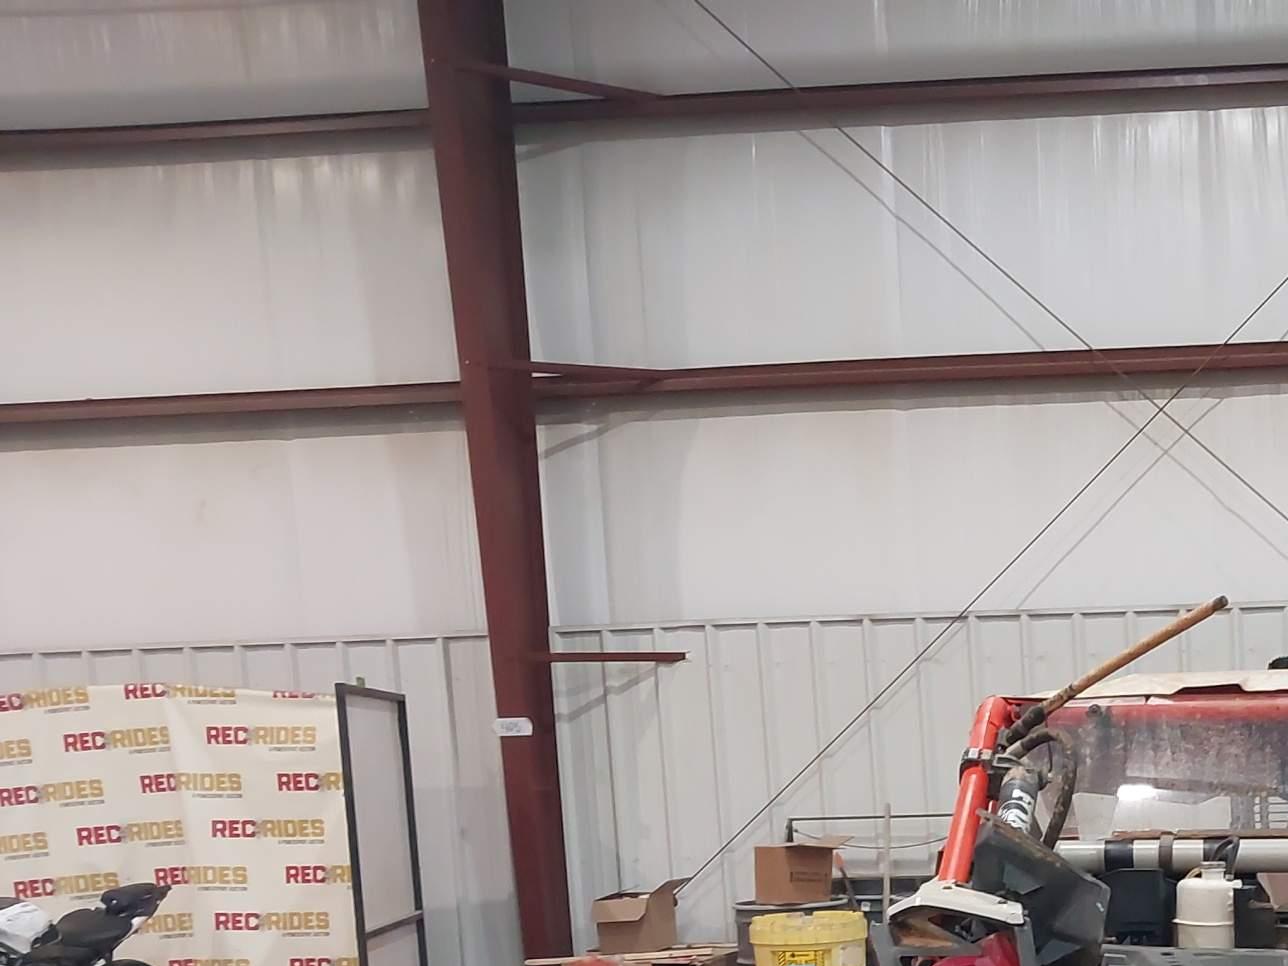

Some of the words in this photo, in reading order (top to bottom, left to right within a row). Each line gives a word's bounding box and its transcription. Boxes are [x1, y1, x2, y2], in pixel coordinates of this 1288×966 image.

[0, 693, 24, 712] EC
[28, 686, 89, 708] RIDES
[124, 682, 167, 700] REC
[63, 731, 106, 752] REC
[110, 726, 170, 749] RIDES
[206, 727, 249, 745] REC
[252, 726, 316, 745] RIDES
[0, 785, 39, 806] REC
[42, 779, 104, 802] RIDES
[140, 773, 176, 794] REC
[177, 773, 242, 792] RIDES
[277, 773, 320, 792] REC
[76, 825, 122, 846] REC
[125, 820, 184, 843] RIDES
[212, 820, 256, 838] REC
[260, 819, 325, 838] RIDES
[0, 832, 48, 854] IDES
[187, 865, 248, 885] RIDES
[285, 865, 327, 884] REC
[14, 878, 56, 899] REC
[56, 872, 119, 895] RIDES
[143, 913, 193, 933] RIDE
[214, 912, 260, 931] REC
[263, 911, 330, 931] RIDES
